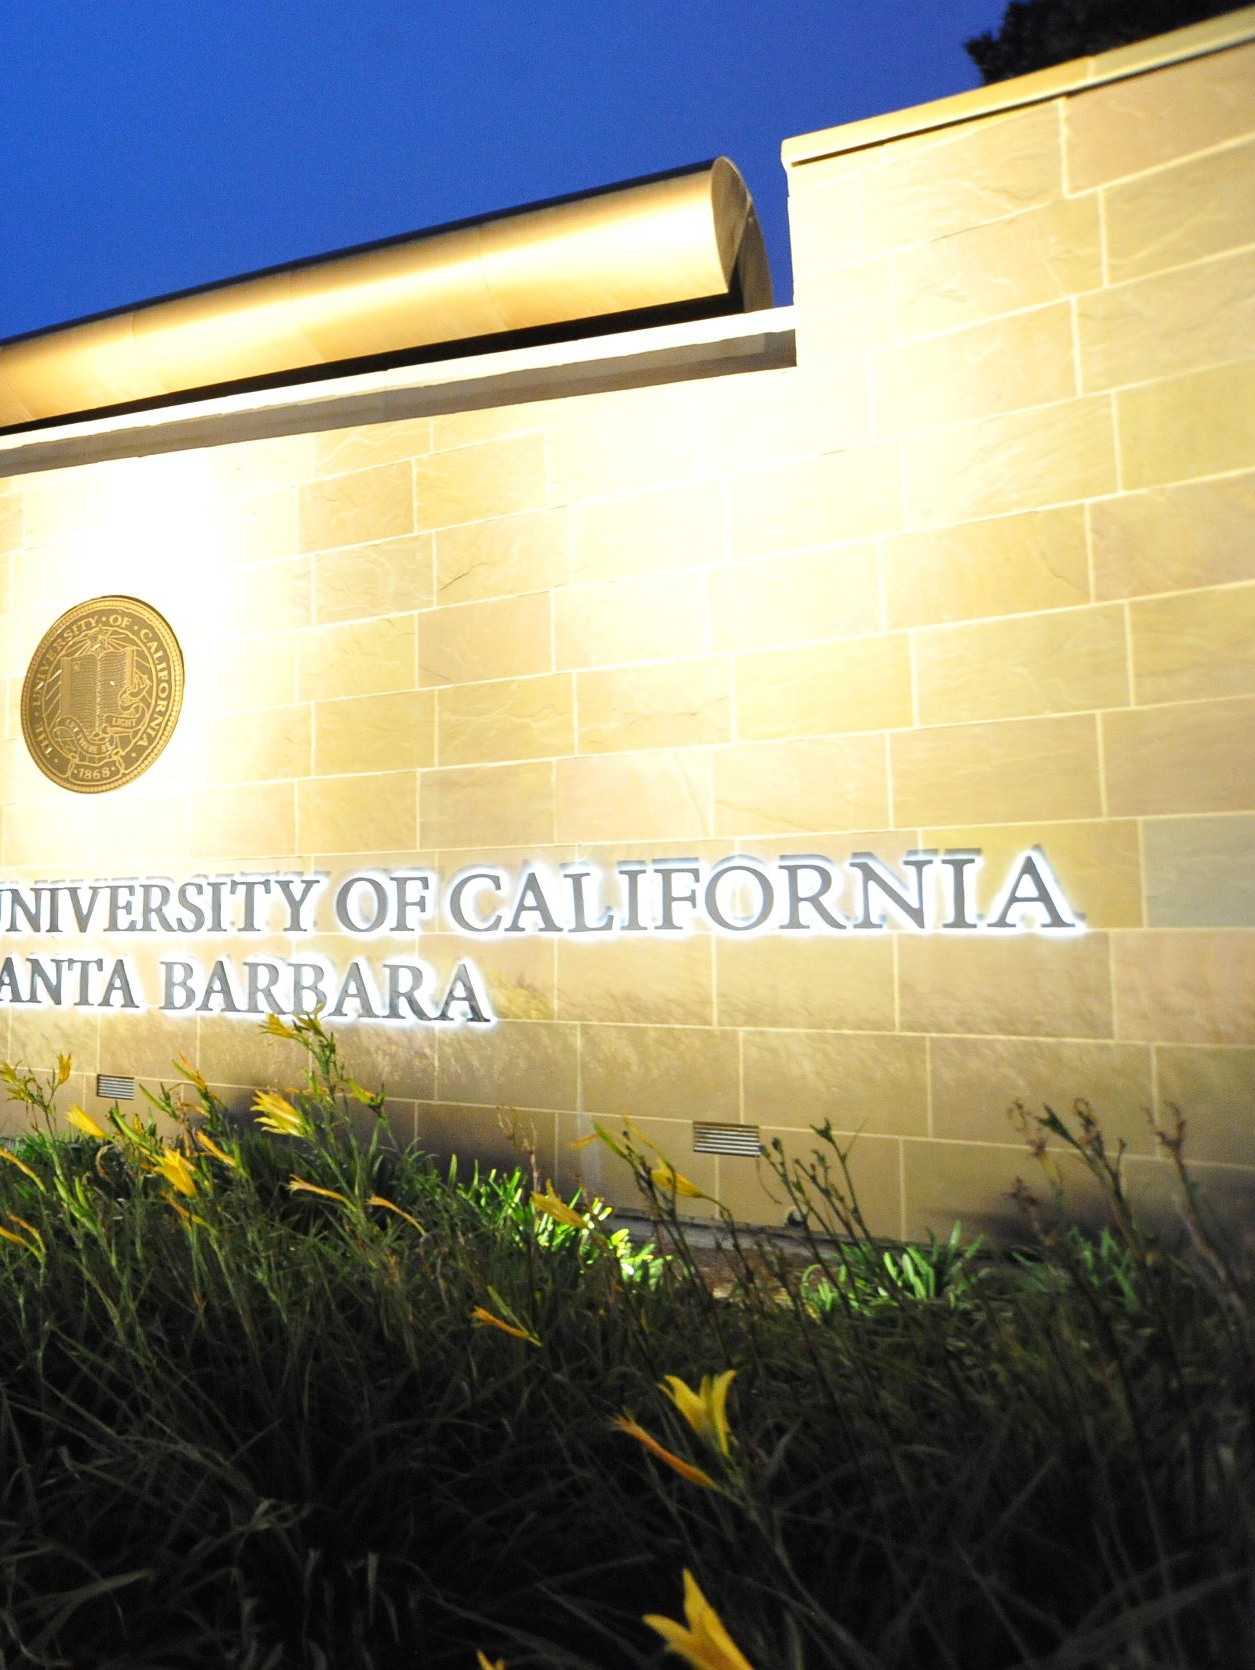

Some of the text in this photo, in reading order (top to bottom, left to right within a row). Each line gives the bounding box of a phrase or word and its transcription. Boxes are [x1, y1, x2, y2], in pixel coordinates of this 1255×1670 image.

[32, 615, 98, 706] UNIVERSITY
[109, 614, 133, 627] OF
[137, 628, 170, 748] CALIFORNIA
[111, 718, 137, 727] LIGHT
[78, 767, 111, 780] 1868
[336, 876, 429, 933] OF
[449, 854, 1076, 933] CALIFORNIA
[160, 960, 492, 1023] BARBARA
